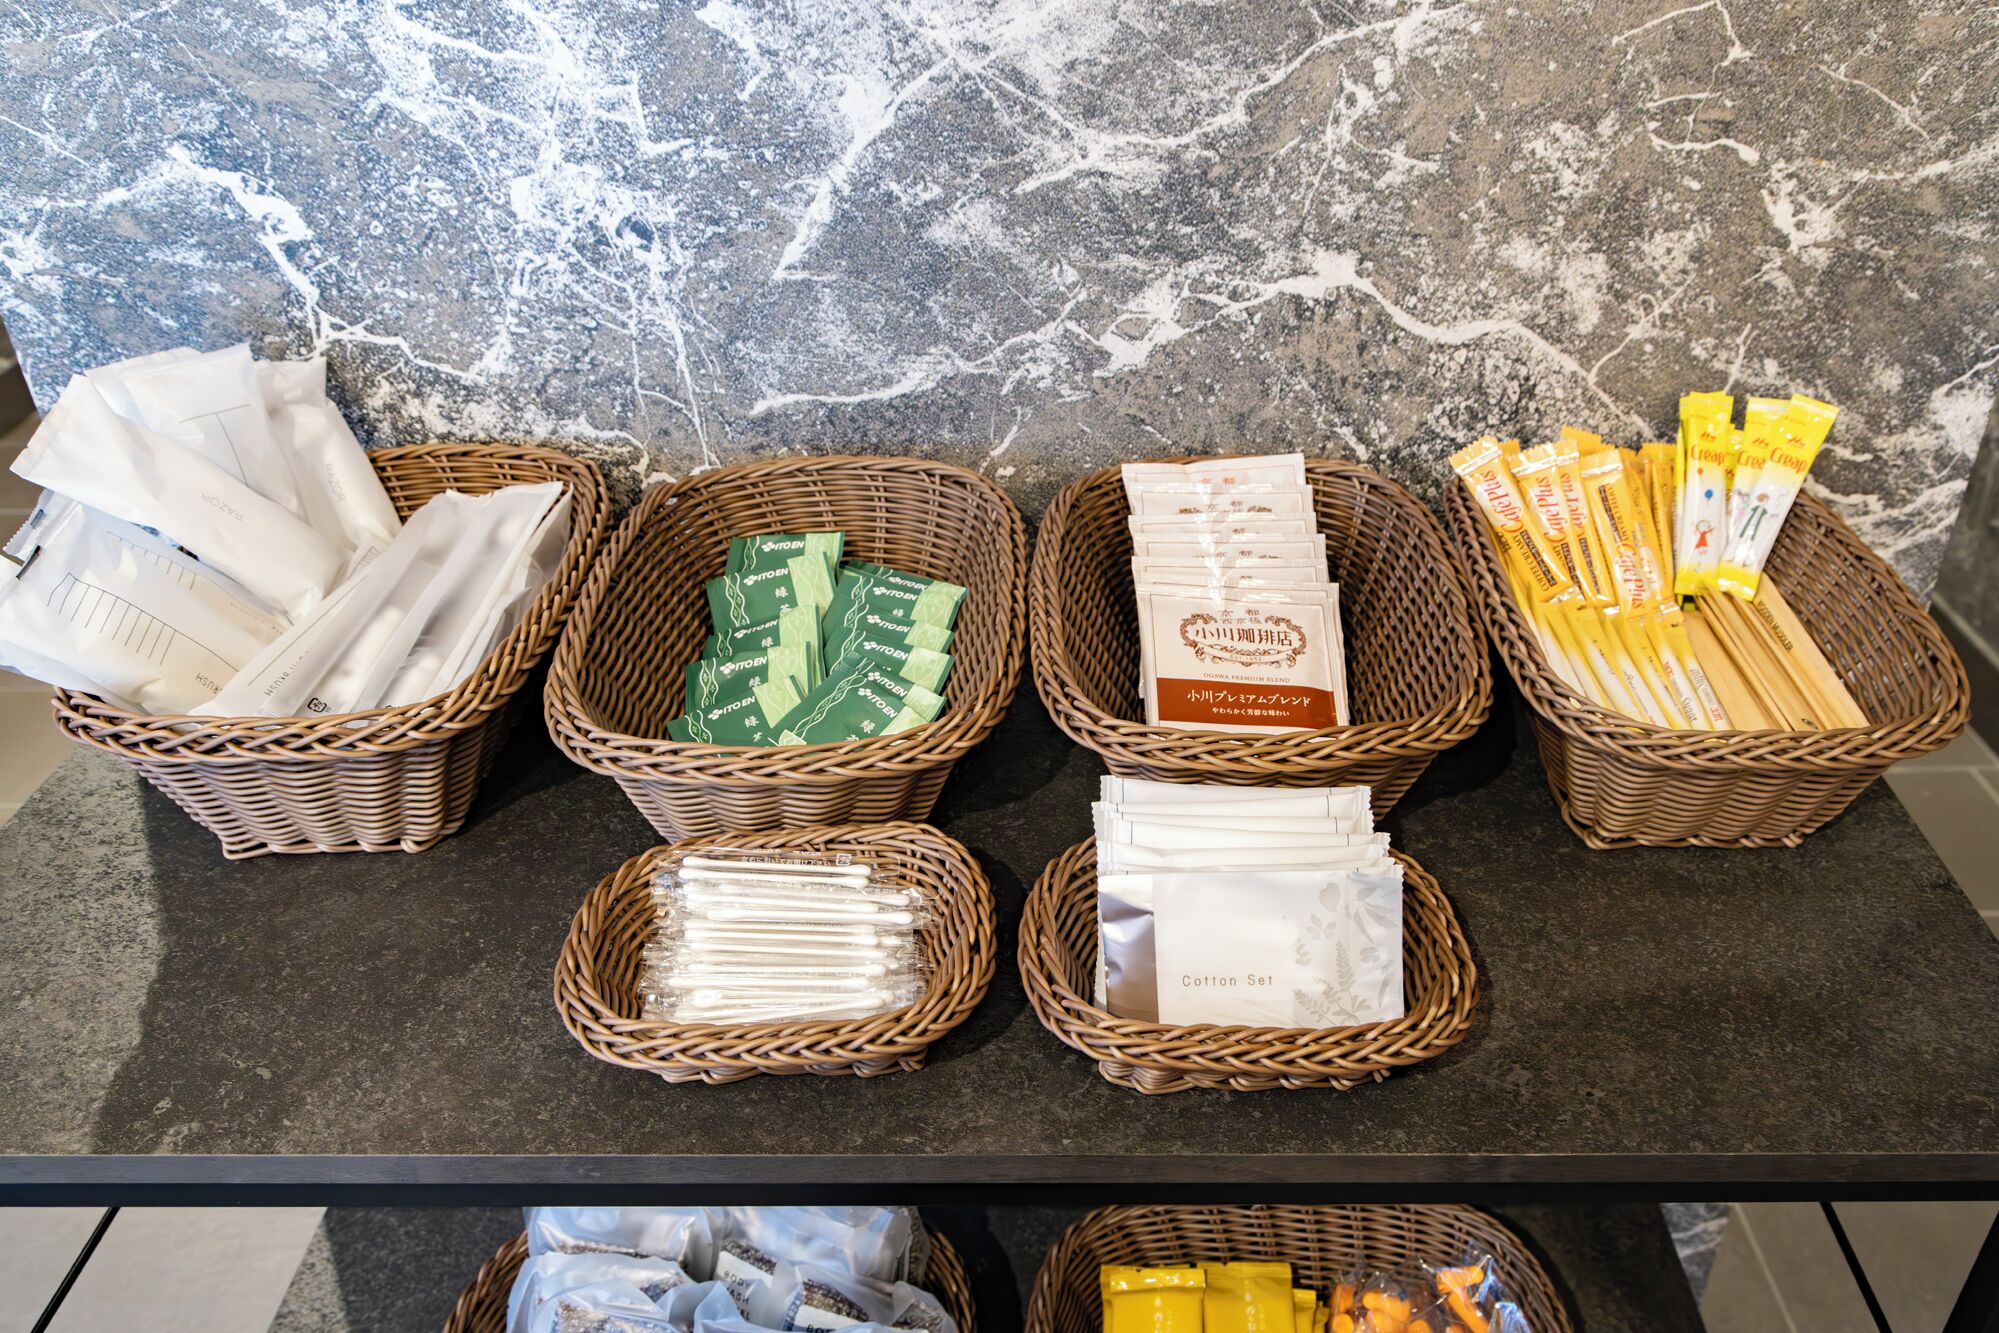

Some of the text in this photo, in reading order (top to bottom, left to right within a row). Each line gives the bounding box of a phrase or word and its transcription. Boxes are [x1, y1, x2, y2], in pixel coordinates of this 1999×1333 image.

[1691, 445, 1724, 465] Creap
[1737, 450, 1767, 469] Crea
[1770, 447, 1808, 474] Creap
[200, 494, 244, 521] RAZOR
[1195, 627, 1293, 647] 小川珈琲店
[195, 672, 223, 695] RUSH
[1203, 672, 1230, 680] OGAWA
[1231, 674, 1265, 682] PREMIUM
[1187, 689, 1311, 708] 小川プレミアムブレンド
[1212, 706, 1290, 717] やわらかく芳醇な味わい
[1182, 973, 1272, 987] Cotton Set
